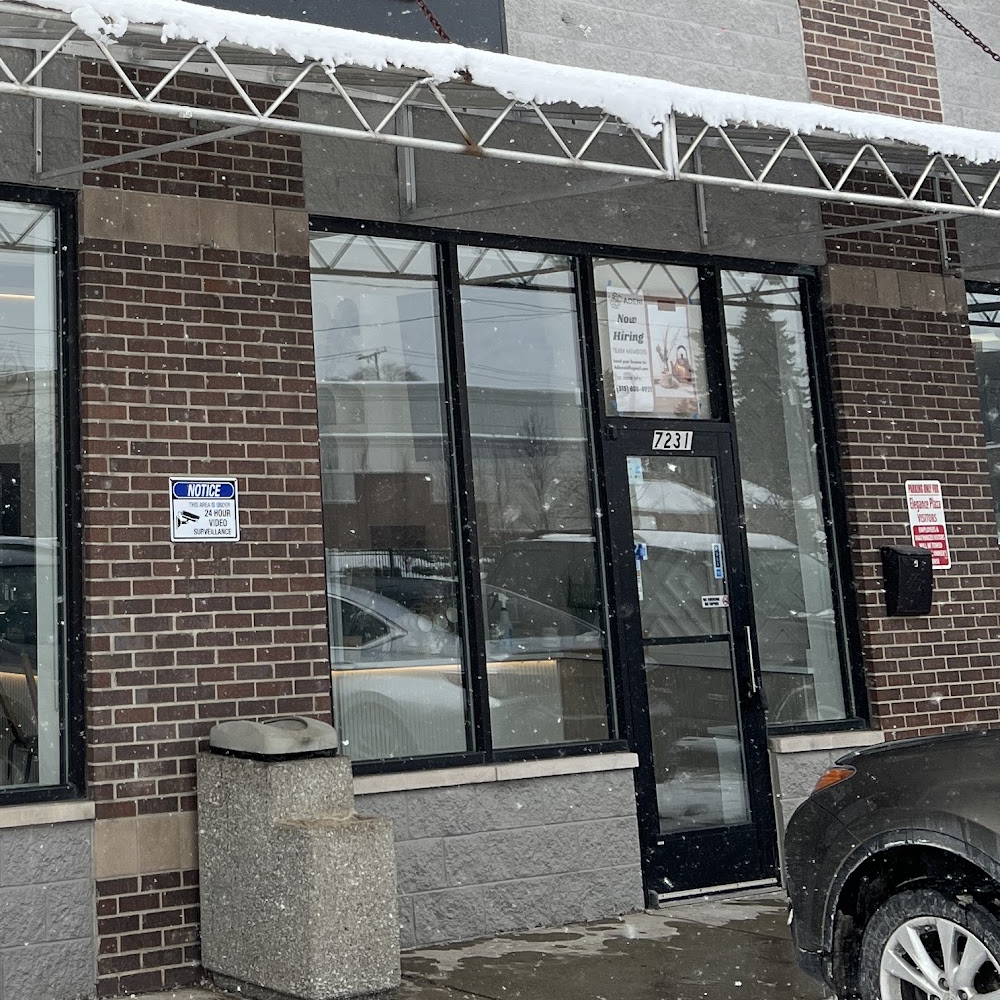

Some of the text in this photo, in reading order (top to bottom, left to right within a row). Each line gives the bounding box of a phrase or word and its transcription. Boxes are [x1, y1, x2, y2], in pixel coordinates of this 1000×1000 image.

[617, 313, 637, 324] Now
[613, 331, 645, 345] Hiring
[655, 432, 689, 449] 7231
[188, 484, 221, 497] NOTICE
[204, 509, 231, 517] 24 HOUR
[209, 519, 228, 527] VIDEO
